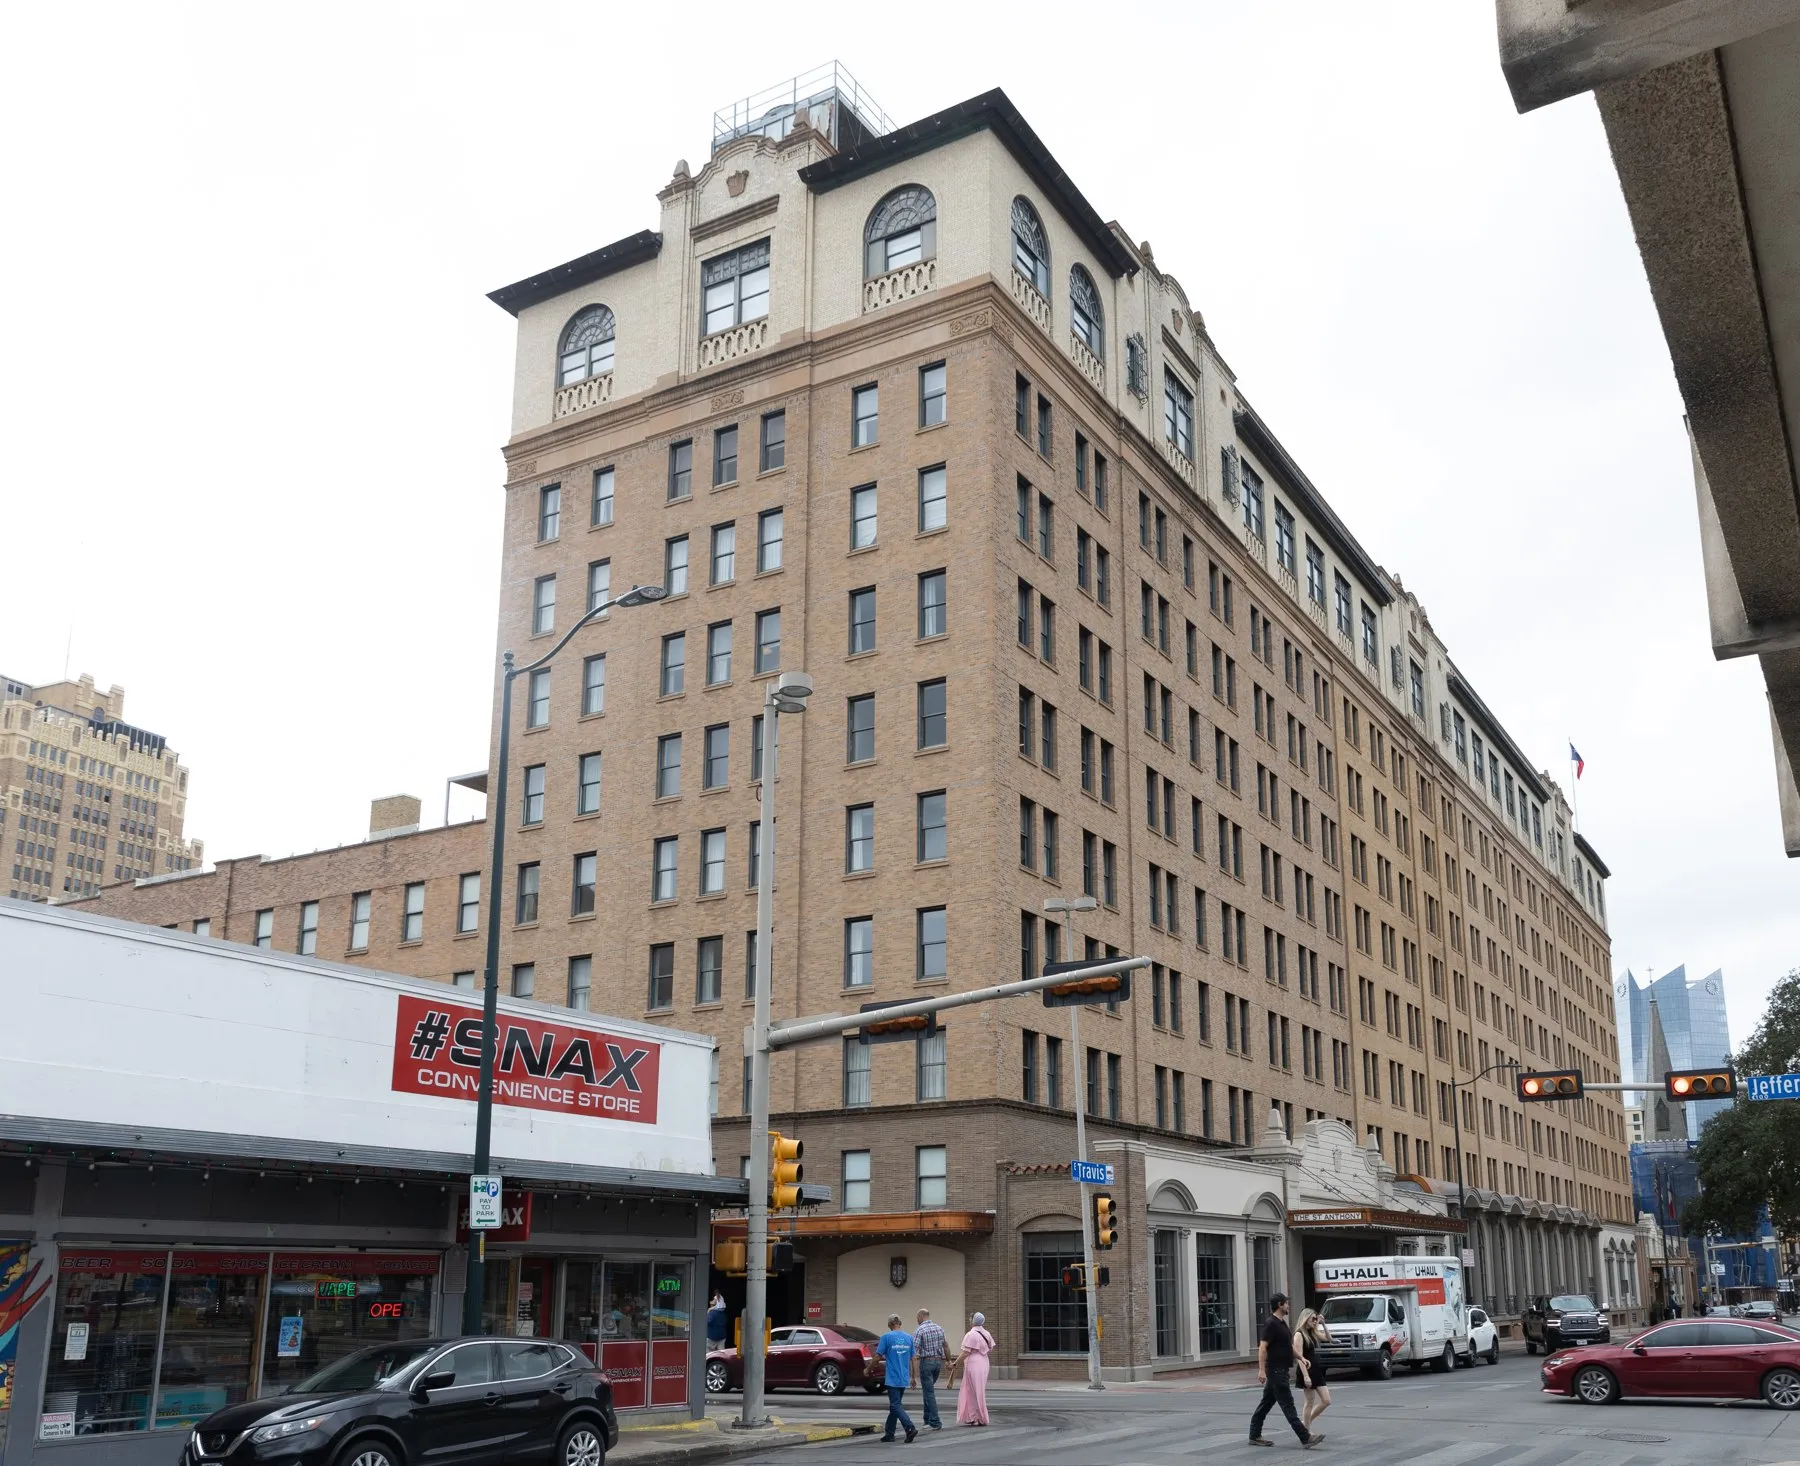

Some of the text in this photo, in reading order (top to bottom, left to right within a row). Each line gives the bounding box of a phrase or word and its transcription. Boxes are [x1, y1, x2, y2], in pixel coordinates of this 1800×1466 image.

[410, 1010, 650, 1093] #SNAX
[418, 1069, 640, 1113] CONVENIENCE STORE
[1751, 1075, 1800, 1095] Jeffer
[1073, 1162, 1105, 1181] E Travis
[1324, 1212, 1361, 1220] ANTHONY
[60, 1256, 112, 1268] BEER
[219, 1258, 269, 1269] CHIPS
[274, 1259, 299, 1270] ICE
[301, 1259, 353, 1270] CREAM
[319, 1282, 357, 1297] VAPE
[657, 1279, 680, 1291] ATM
